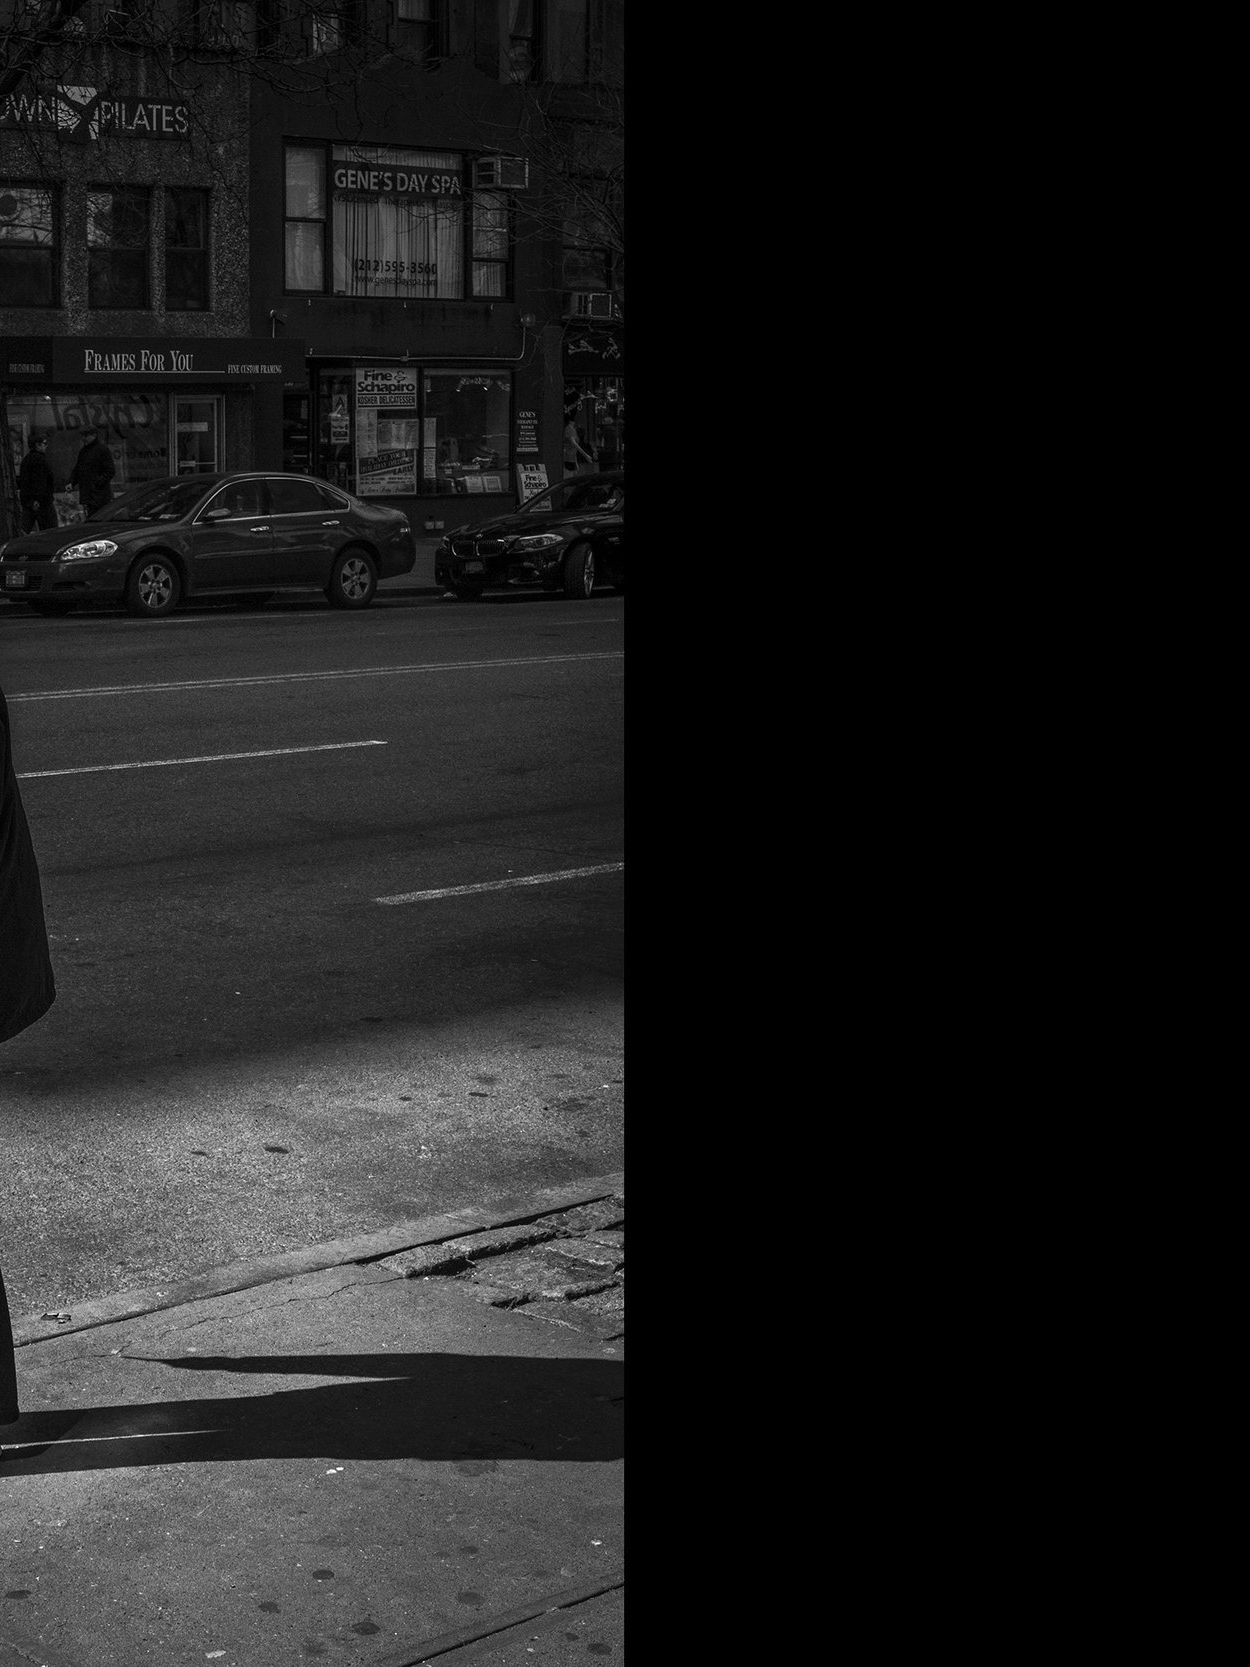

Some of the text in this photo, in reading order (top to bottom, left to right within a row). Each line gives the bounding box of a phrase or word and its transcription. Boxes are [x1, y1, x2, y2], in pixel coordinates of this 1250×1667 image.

[101, 101, 189, 133] PILATES
[334, 169, 461, 195] GENE'S DAY SPA
[354, 258, 438, 275] (212)595-3560
[83, 349, 195, 372] FRAMES FOR YOU
[227, 364, 282, 374] FINE CUSTOM FRAMING
[364, 369, 408, 382] Fine &
[357, 381, 415, 395] Schapiro
[358, 395, 415, 405] KOSHER DELICATESSEN
